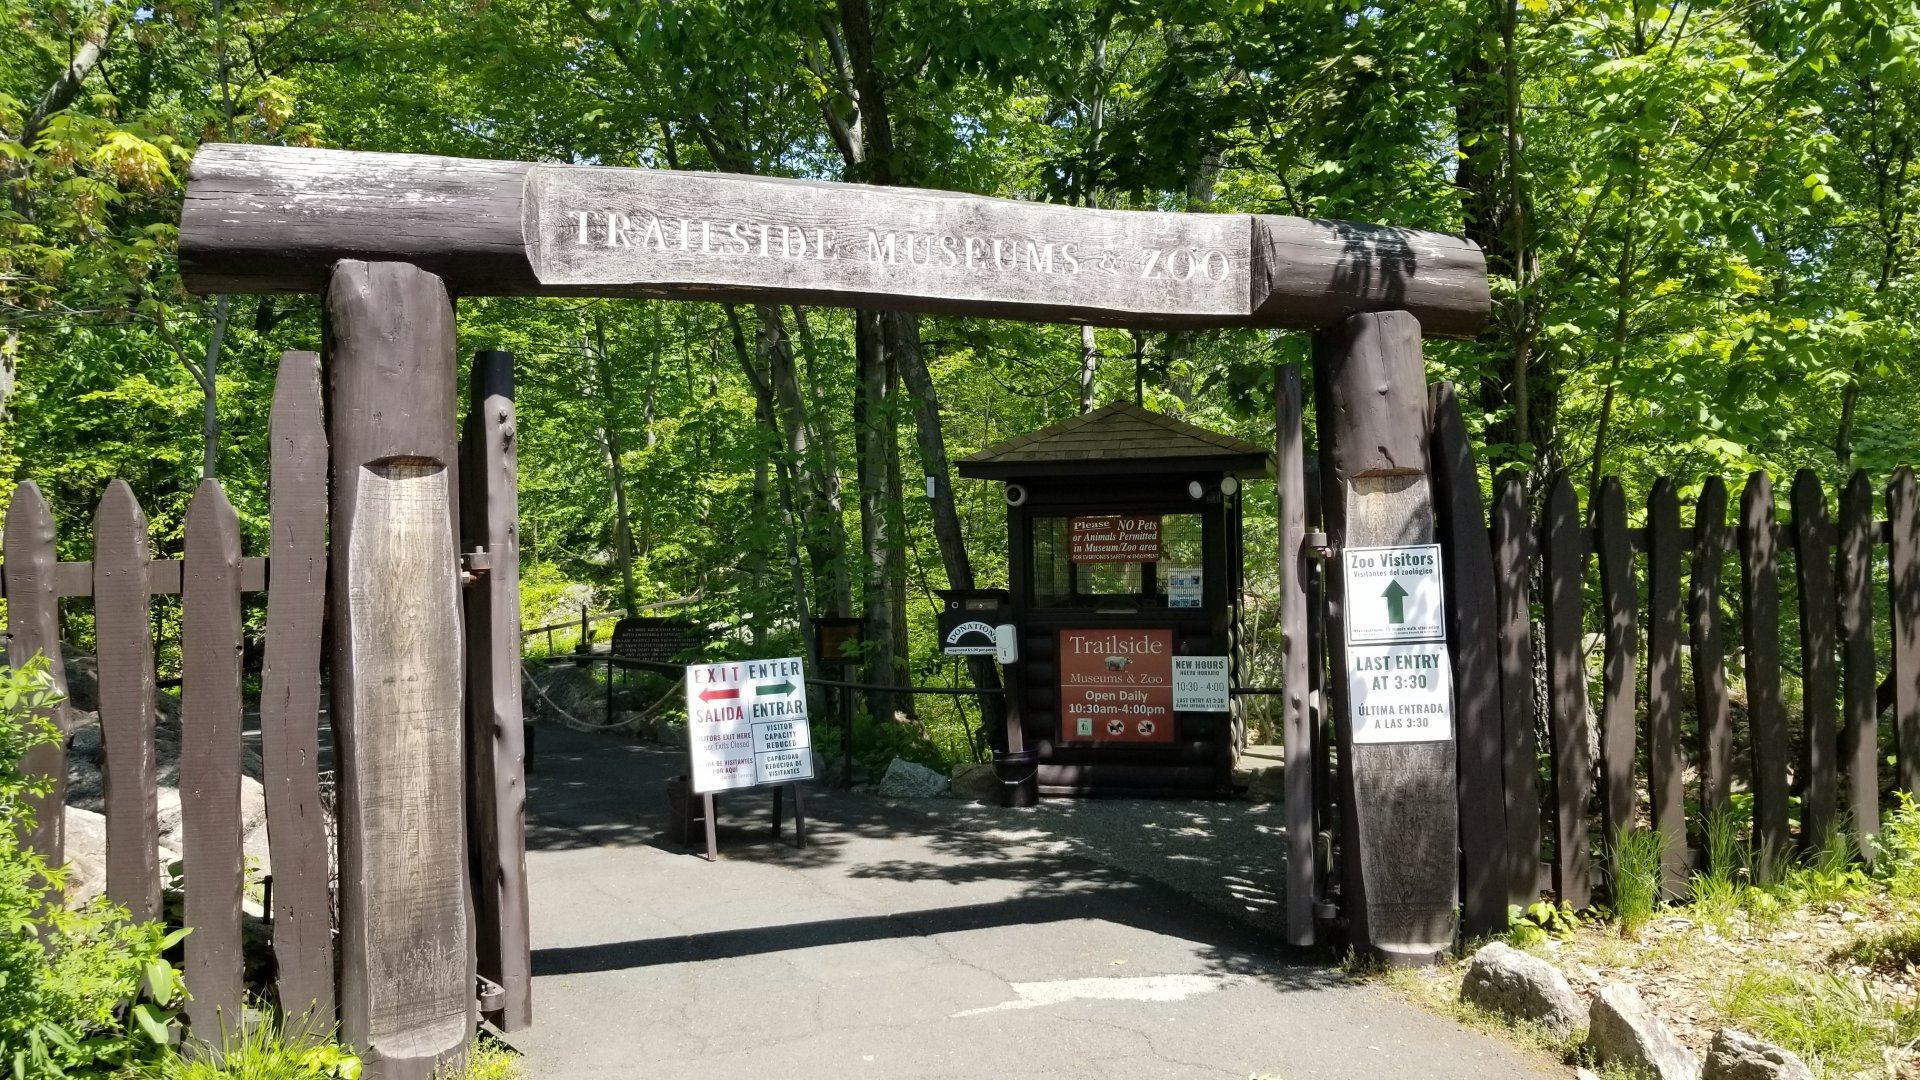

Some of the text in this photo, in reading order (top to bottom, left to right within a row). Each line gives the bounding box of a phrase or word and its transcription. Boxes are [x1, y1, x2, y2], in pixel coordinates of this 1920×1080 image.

[569, 210, 1231, 282] TRAILSIDE MUSEUMS & ZOO
[1073, 520, 1157, 531] Please NO Pets
[1084, 532, 1116, 541] Animals
[1119, 531, 1158, 540] Permitted
[1073, 544, 1082, 552] in
[1085, 543, 1137, 552] Museum/Zoo
[1351, 552, 1434, 569] Zoo Visitors
[1353, 567, 1433, 578] Visitantes del zoológico
[950, 623, 996, 642] DONATIONS
[1069, 635, 1163, 655] Trailside
[1175, 661, 1224, 669] NEW HOURS
[1356, 654, 1440, 671] LAST ENTRY
[694, 666, 739, 684] EXIT
[748, 661, 800, 679] ENTER
[1070, 673, 1163, 684] Museums & Zoo
[1372, 674, 1427, 690] AT 3:30
[1176, 682, 1199, 691] 10:30
[1207, 682, 1224, 691] 4:00
[1085, 690, 1148, 702] Open Daily
[696, 705, 744, 723] SALIDA
[752, 700, 803, 718] ENTRAR
[1068, 703, 1165, 717] 10:30am-4:00pm
[1358, 702, 1444, 717] ÚLTIMA ENTRADA
[766, 723, 793, 732] VISITOR
[1374, 717, 1429, 729] A LAS 3:30
[696, 734, 722, 742] ISITORS
[722, 733, 735, 741] EXIT
[764, 731, 797, 740] CAPACITY
[730, 740, 750, 749] Closed
[766, 740, 797, 749] REDUCED
[724, 758, 753, 766] VISITANTES
[766, 753, 799, 762] CAPACIDAD
[725, 765, 738, 773] AQUÍ
[765, 761, 794, 770] REDUCIDA
[768, 768, 800, 777] VISITANTES
